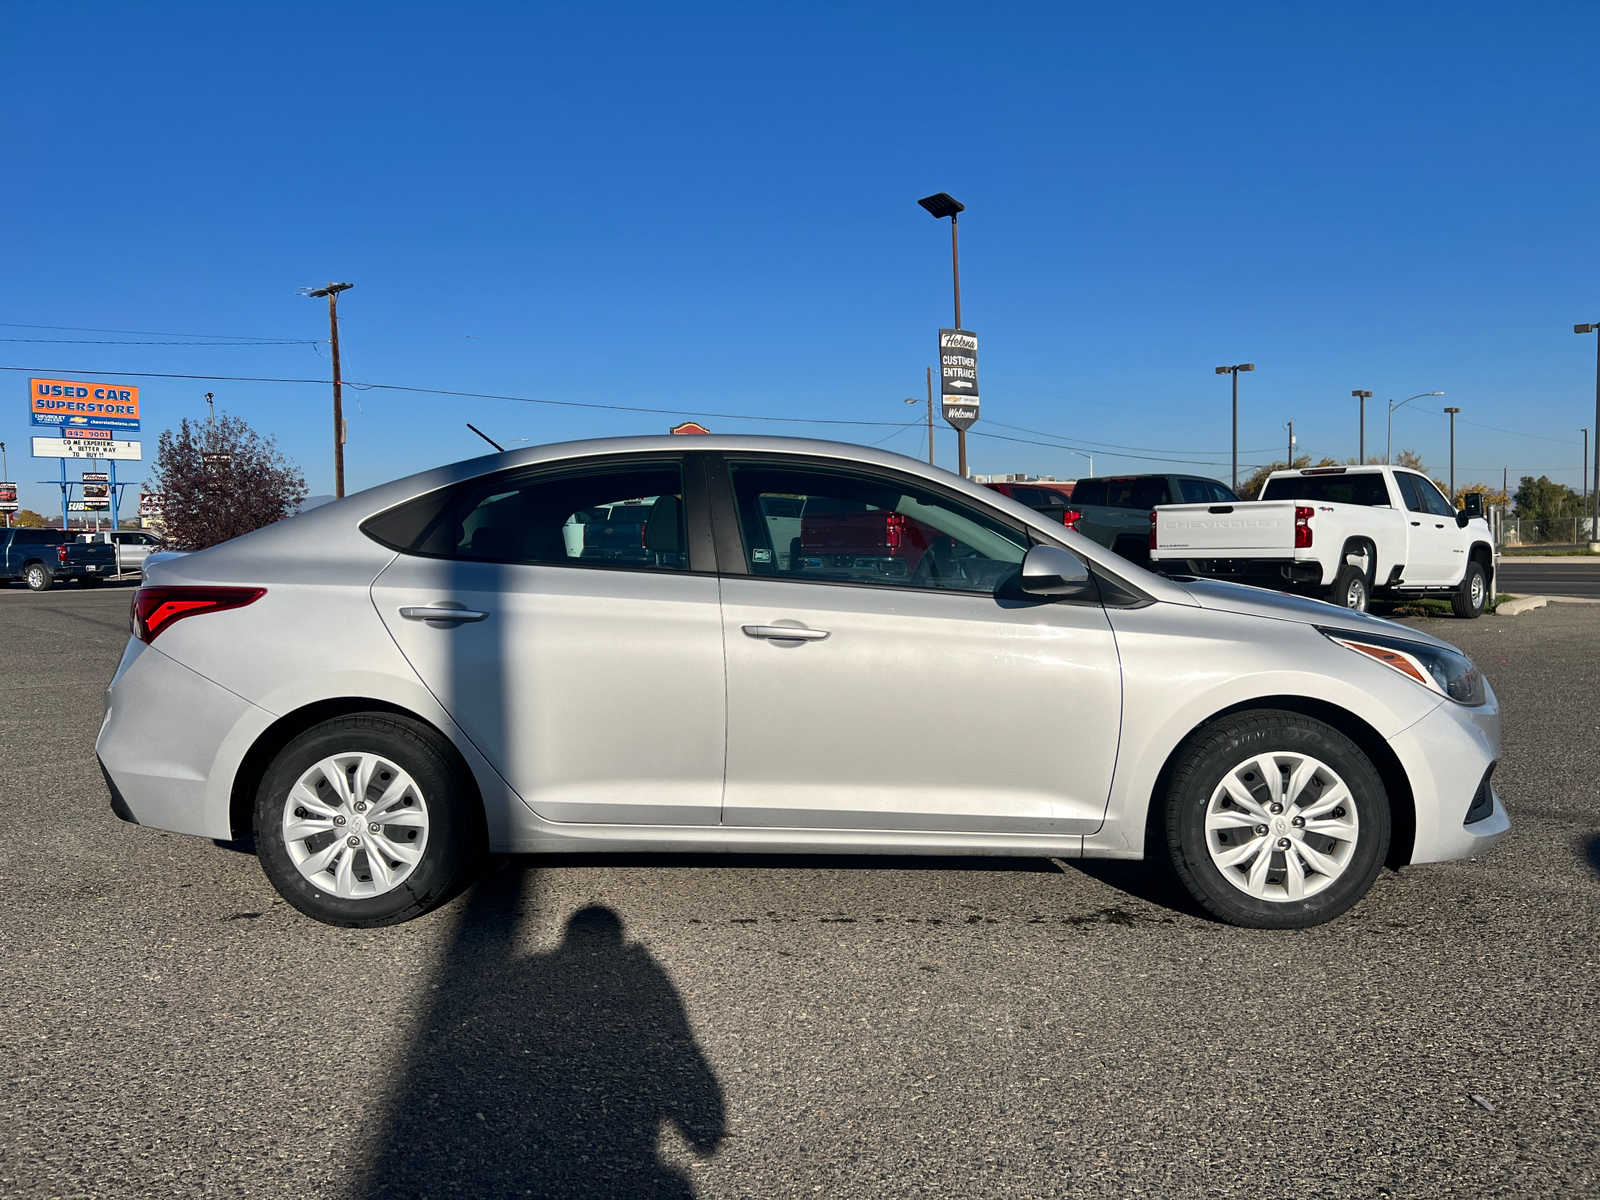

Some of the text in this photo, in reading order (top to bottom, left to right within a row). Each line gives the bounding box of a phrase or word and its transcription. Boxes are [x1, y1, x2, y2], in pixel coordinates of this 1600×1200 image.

[39, 384, 131, 402] USED CAR
[36, 399, 135, 414] SUPERSTORE
